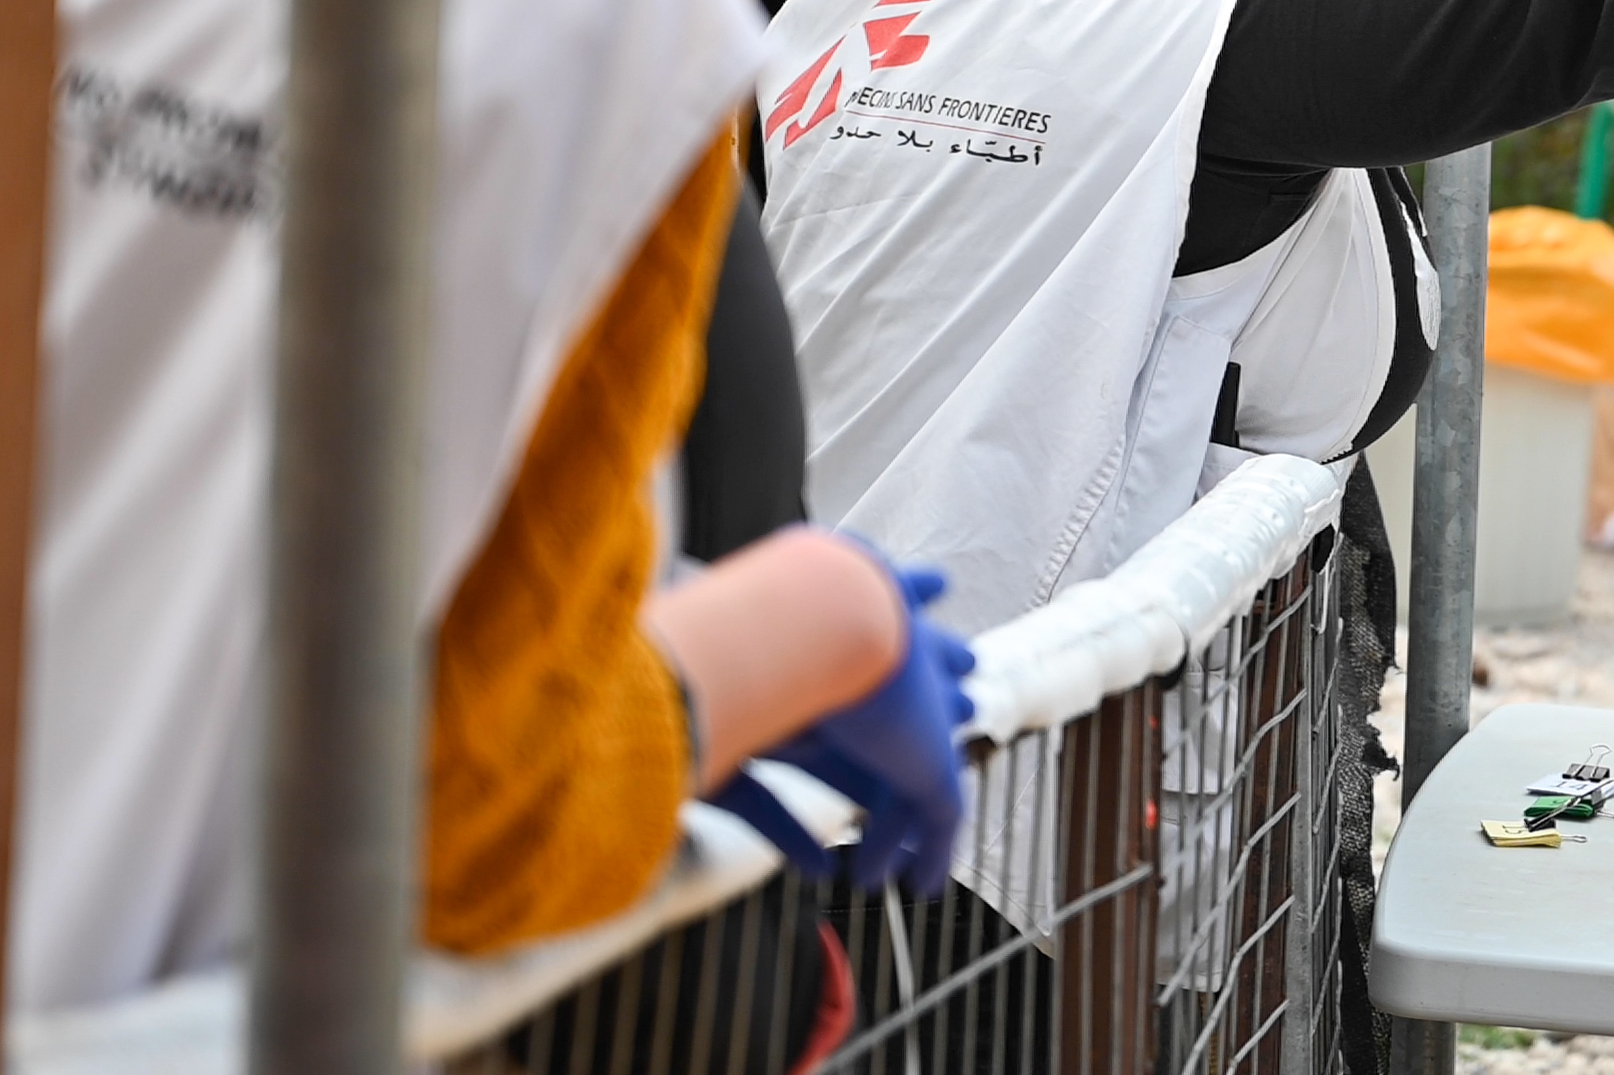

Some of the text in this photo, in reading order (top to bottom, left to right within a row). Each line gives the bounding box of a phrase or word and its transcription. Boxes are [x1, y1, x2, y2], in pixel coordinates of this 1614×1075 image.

[895, 91, 936, 114] SANS
[938, 97, 1052, 134] FRONTIERES
[897, 130, 934, 153] بلا
